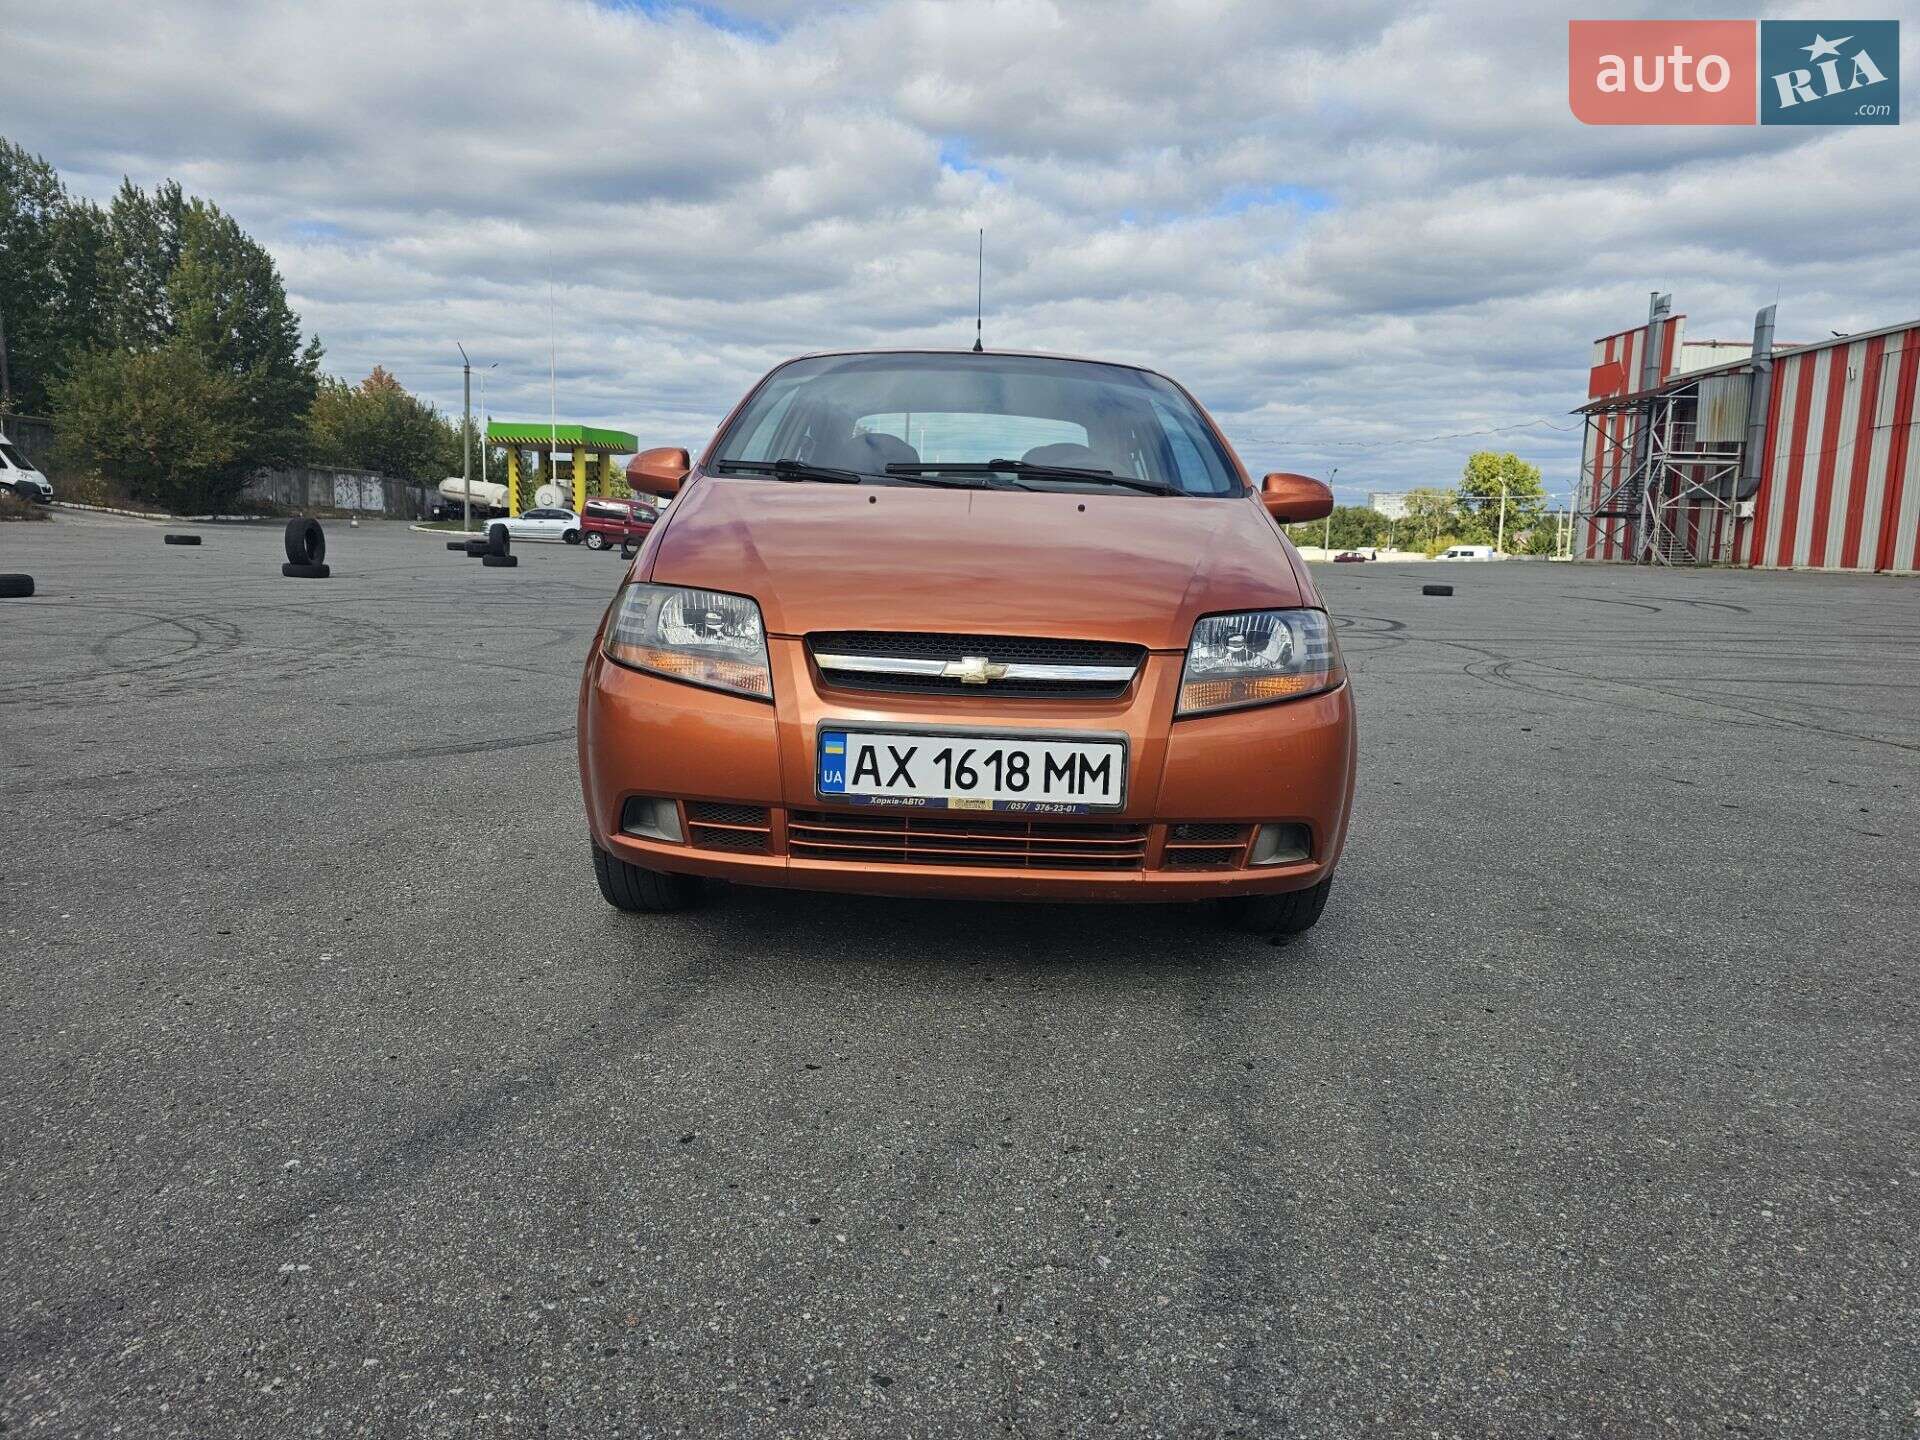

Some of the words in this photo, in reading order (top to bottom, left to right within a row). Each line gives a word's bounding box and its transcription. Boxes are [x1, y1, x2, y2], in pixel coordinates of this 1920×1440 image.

[824, 770, 843, 784] UA
[852, 745, 918, 788] AX
[933, 747, 1030, 792] 1618
[1043, 751, 1112, 796] MM
[1034, 804, 1077, 813] 376-23-01
